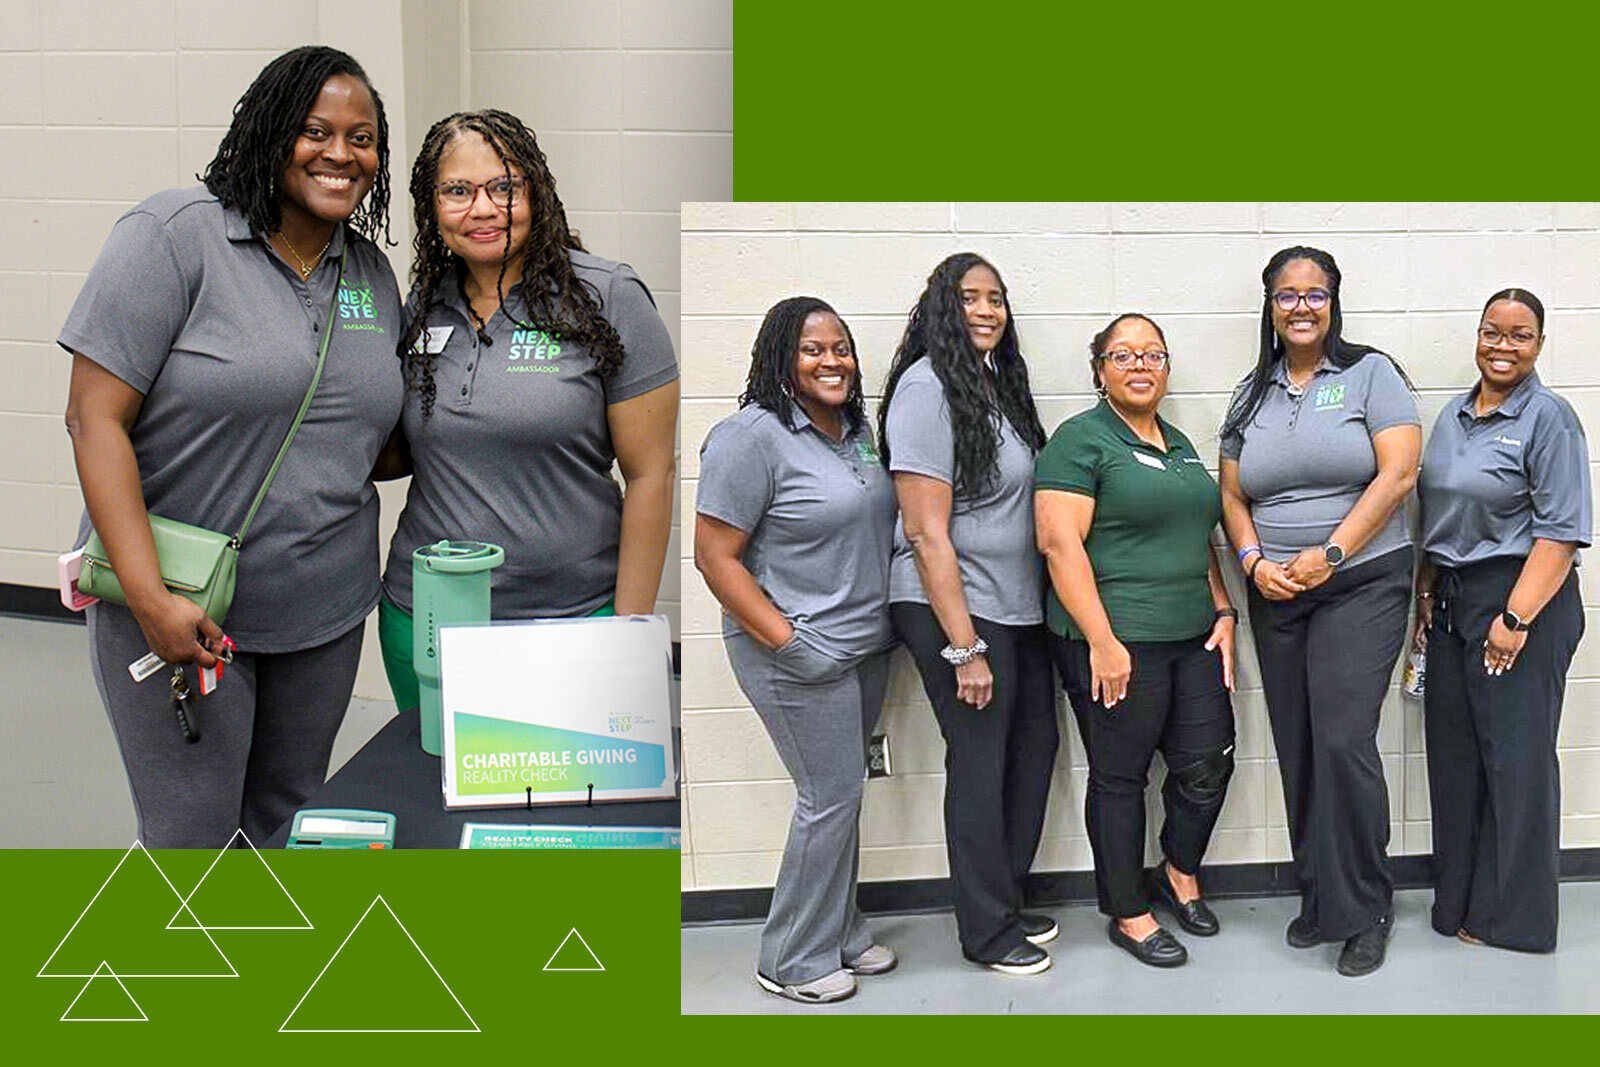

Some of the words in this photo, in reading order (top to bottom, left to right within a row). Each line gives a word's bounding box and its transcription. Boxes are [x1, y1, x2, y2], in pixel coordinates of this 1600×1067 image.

[338, 288, 376, 306] NEX
[508, 344, 562, 360] STEP
[505, 365, 560, 373] AMBASSADOR
[608, 715, 632, 725] NEXT
[608, 723, 632, 733] STEP
[462, 751, 572, 769] CHARITABLE
[575, 748, 638, 766] GIVING
[462, 769, 519, 784] REALITY
[520, 767, 569, 782] CHECK
[484, 835, 532, 843] REALITY
[533, 836, 573, 844] CHECK
